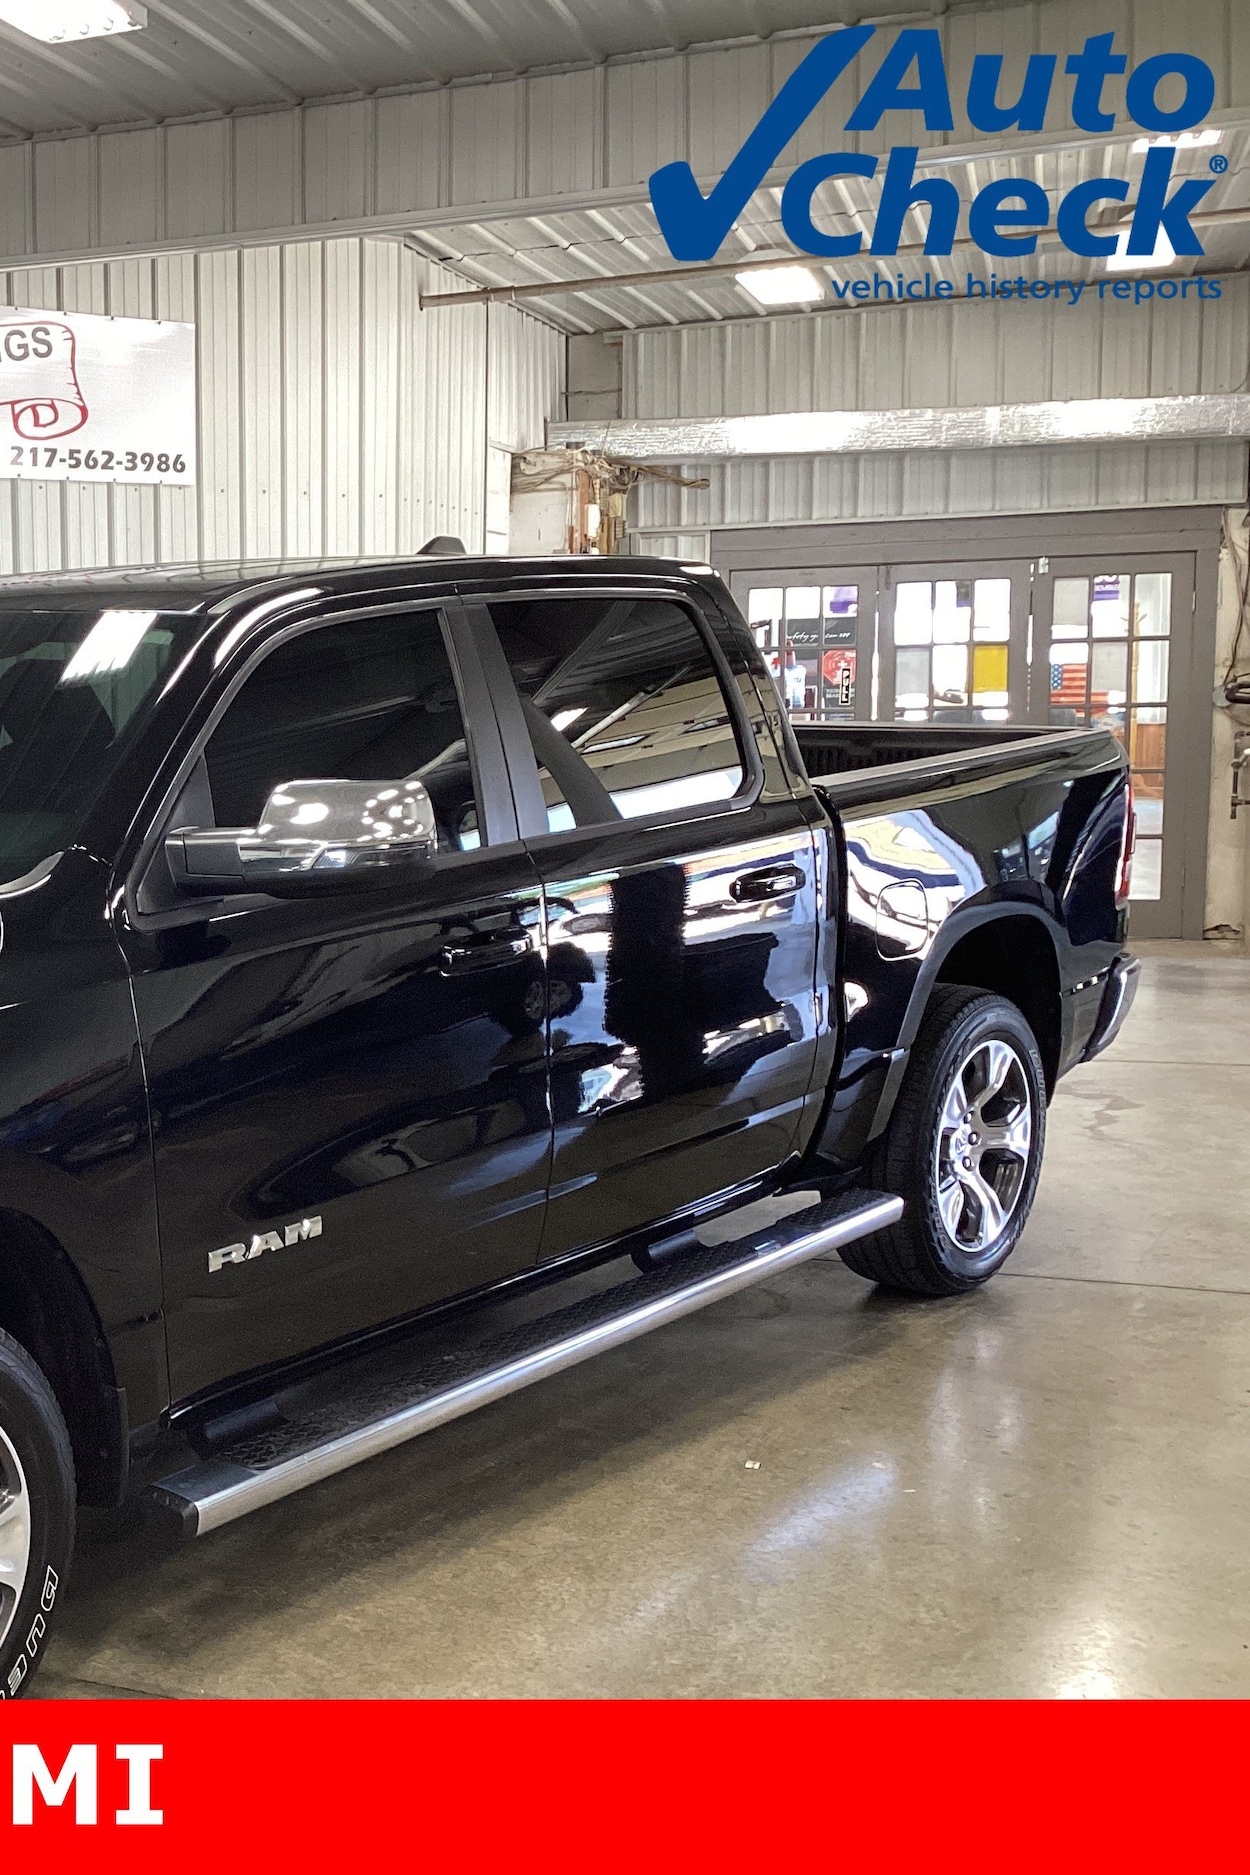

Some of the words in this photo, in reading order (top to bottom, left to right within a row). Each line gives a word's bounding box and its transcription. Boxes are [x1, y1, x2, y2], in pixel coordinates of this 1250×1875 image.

[10, 445, 187, 474] 217-562-3986
[841, 669, 850, 703] PULL
[208, 1215, 323, 1273] RAM
